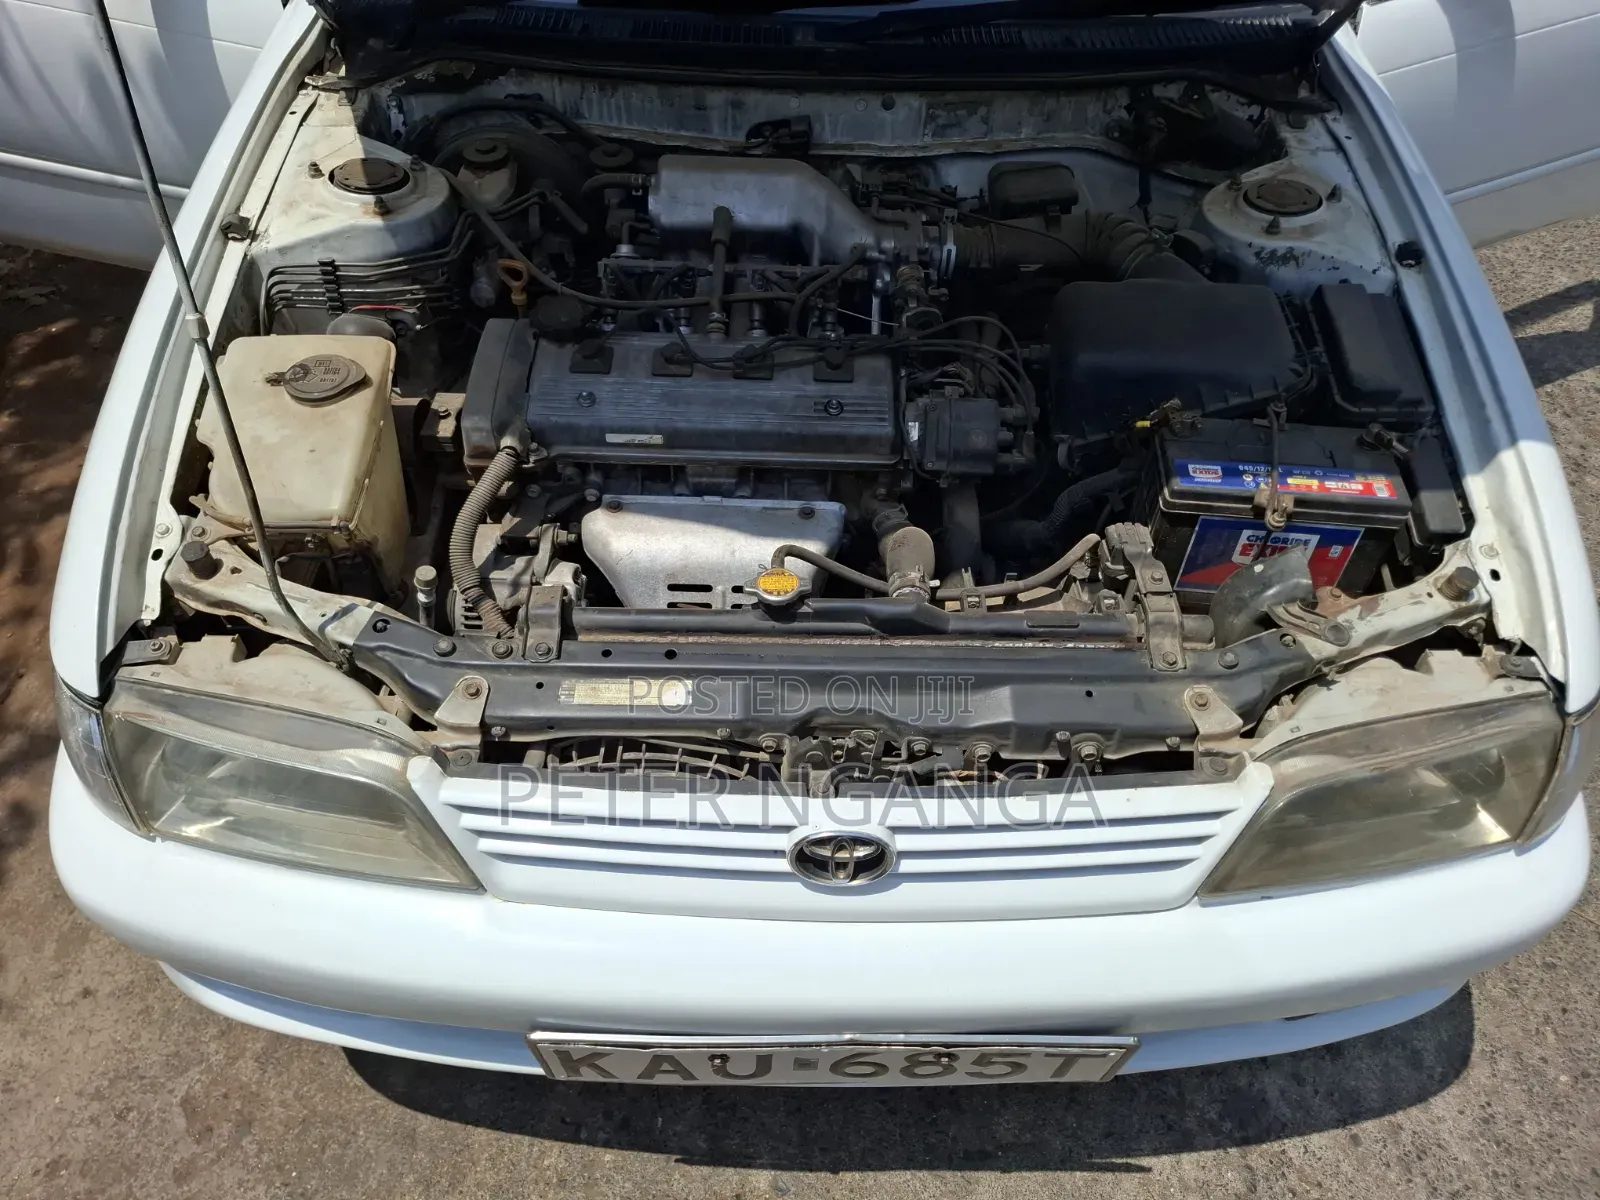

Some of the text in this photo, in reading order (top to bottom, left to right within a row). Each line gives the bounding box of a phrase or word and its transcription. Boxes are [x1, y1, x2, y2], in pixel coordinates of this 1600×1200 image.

[1246, 534, 1312, 546] CHORIDE
[553, 1049, 1108, 1081] KAU 685T
